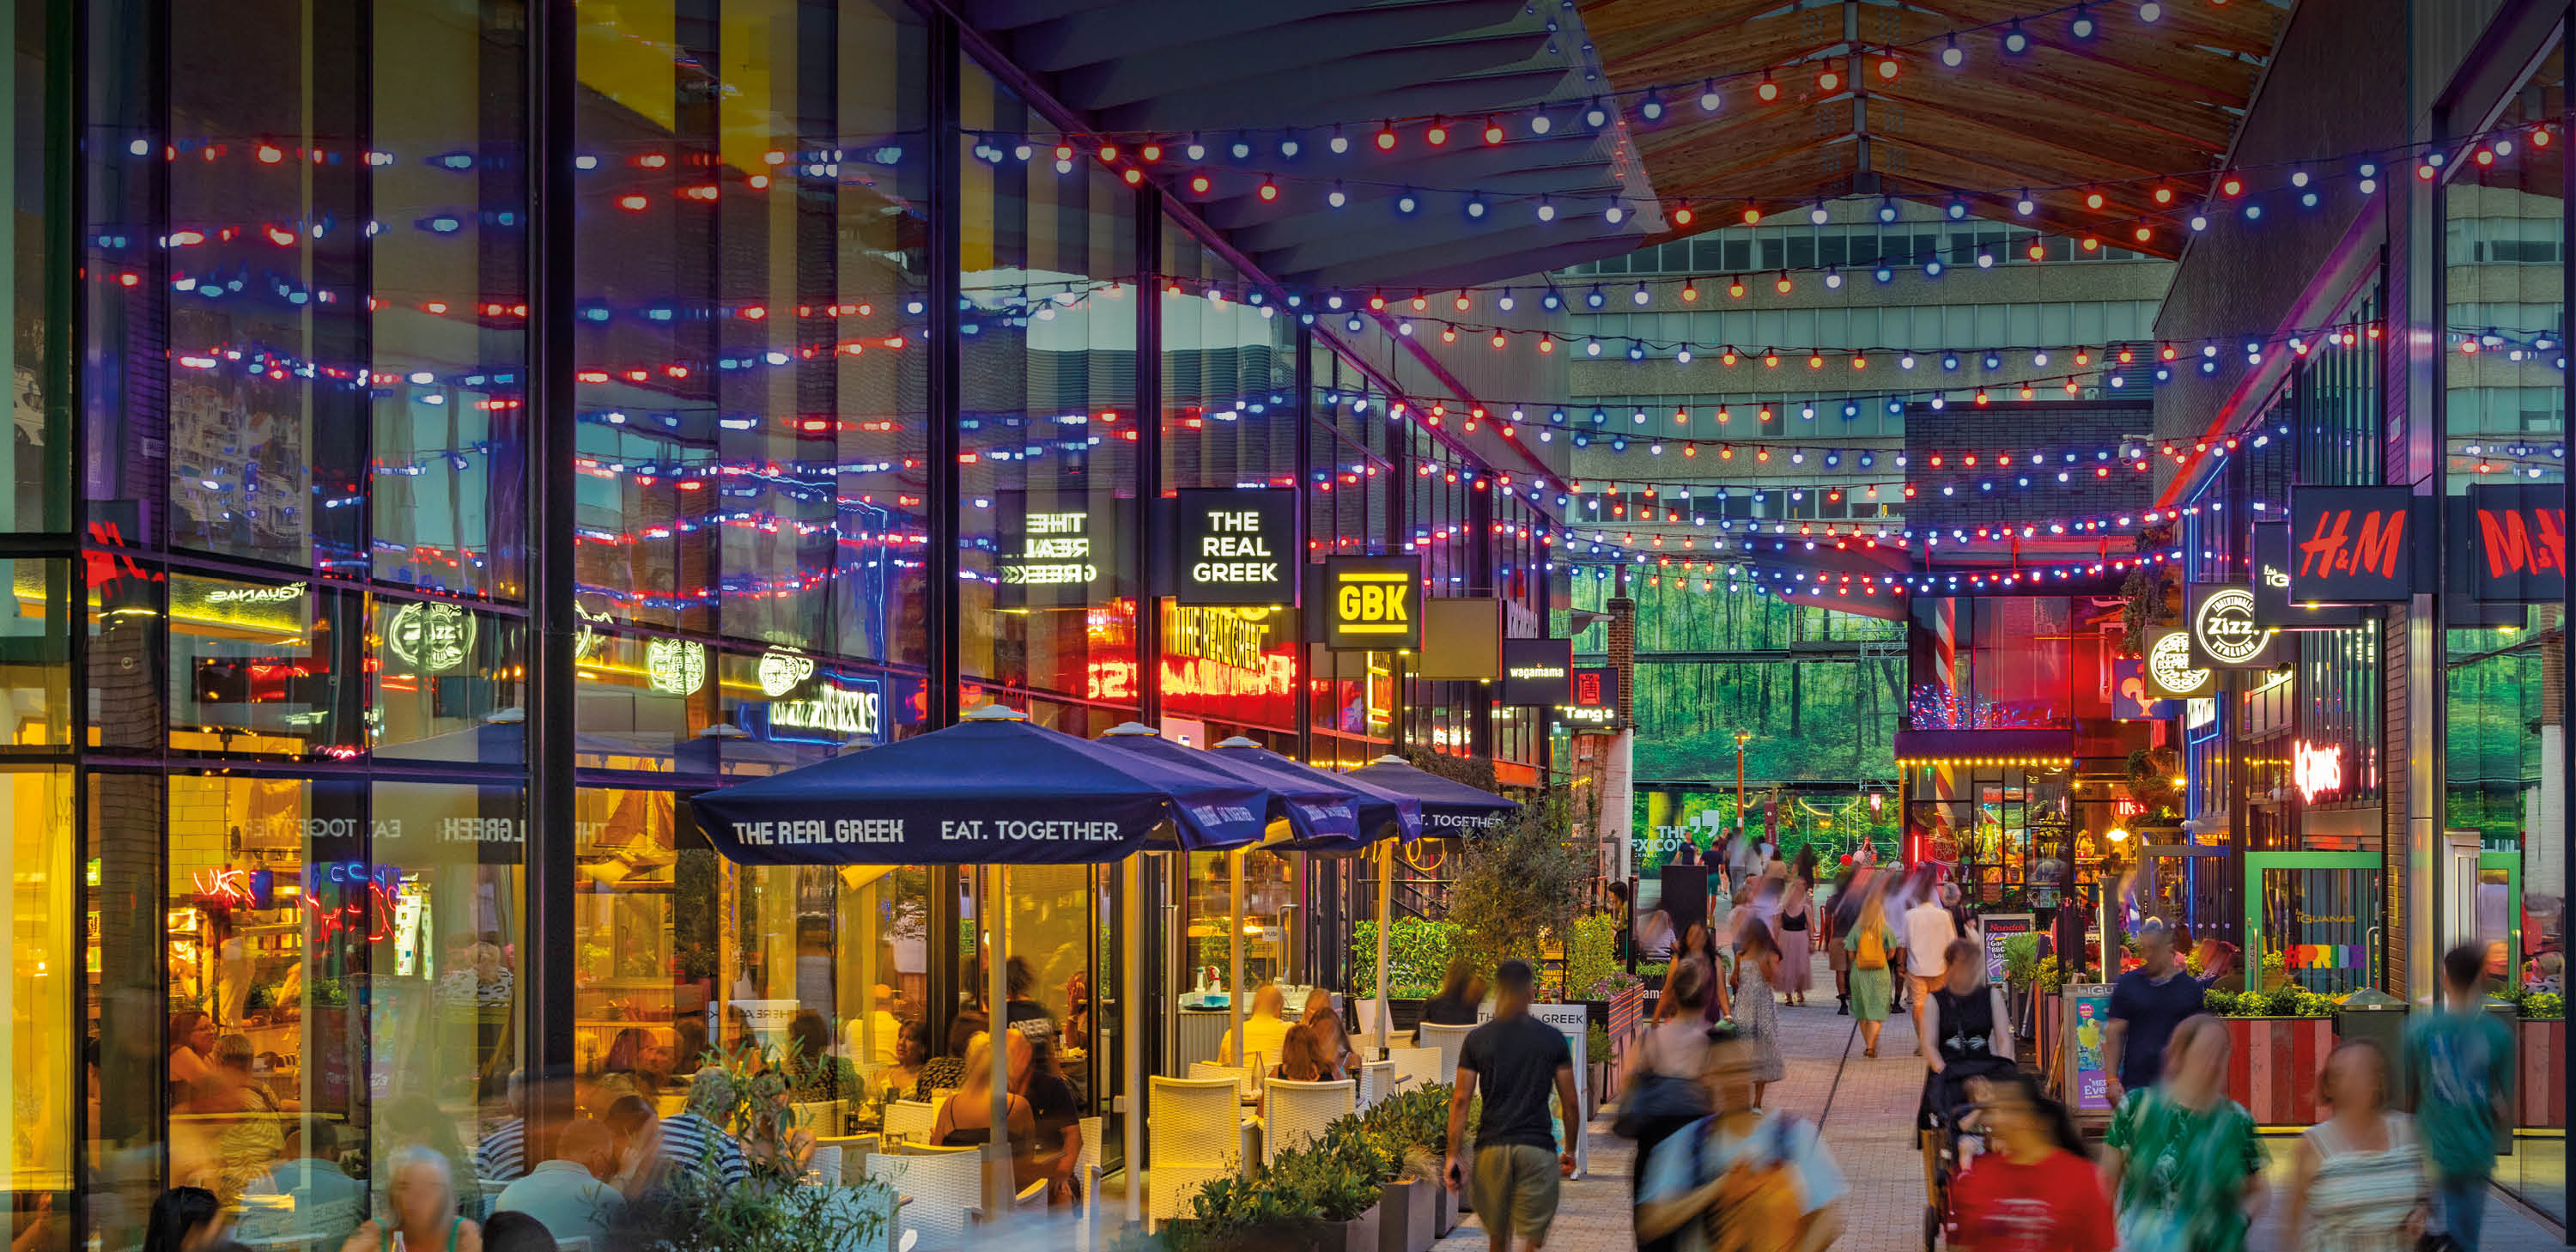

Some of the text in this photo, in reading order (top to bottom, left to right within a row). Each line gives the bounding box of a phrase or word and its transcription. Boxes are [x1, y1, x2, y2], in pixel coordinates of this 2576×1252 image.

[1207, 512, 1259, 531] THE
[1203, 537, 1271, 556] REAL
[2299, 510, 2405, 578] H&M
[1193, 562, 1279, 581] GREEK
[1340, 586, 1407, 620] GBK
[2208, 617, 2260, 635] Zizz
[2212, 641, 2256, 657] ITALIAN
[1510, 668, 1564, 679] wagamama
[1564, 706, 1614, 722] Tang's
[732, 819, 1123, 845] THE REAL GREEK EAT. TOGETHER.
[1990, 923, 2026, 932] Nando's
[2297, 915, 2356, 924] IGUANAS
[2284, 945, 2365, 969] #PRIDE
[1542, 1013, 1583, 1024] GREEK
